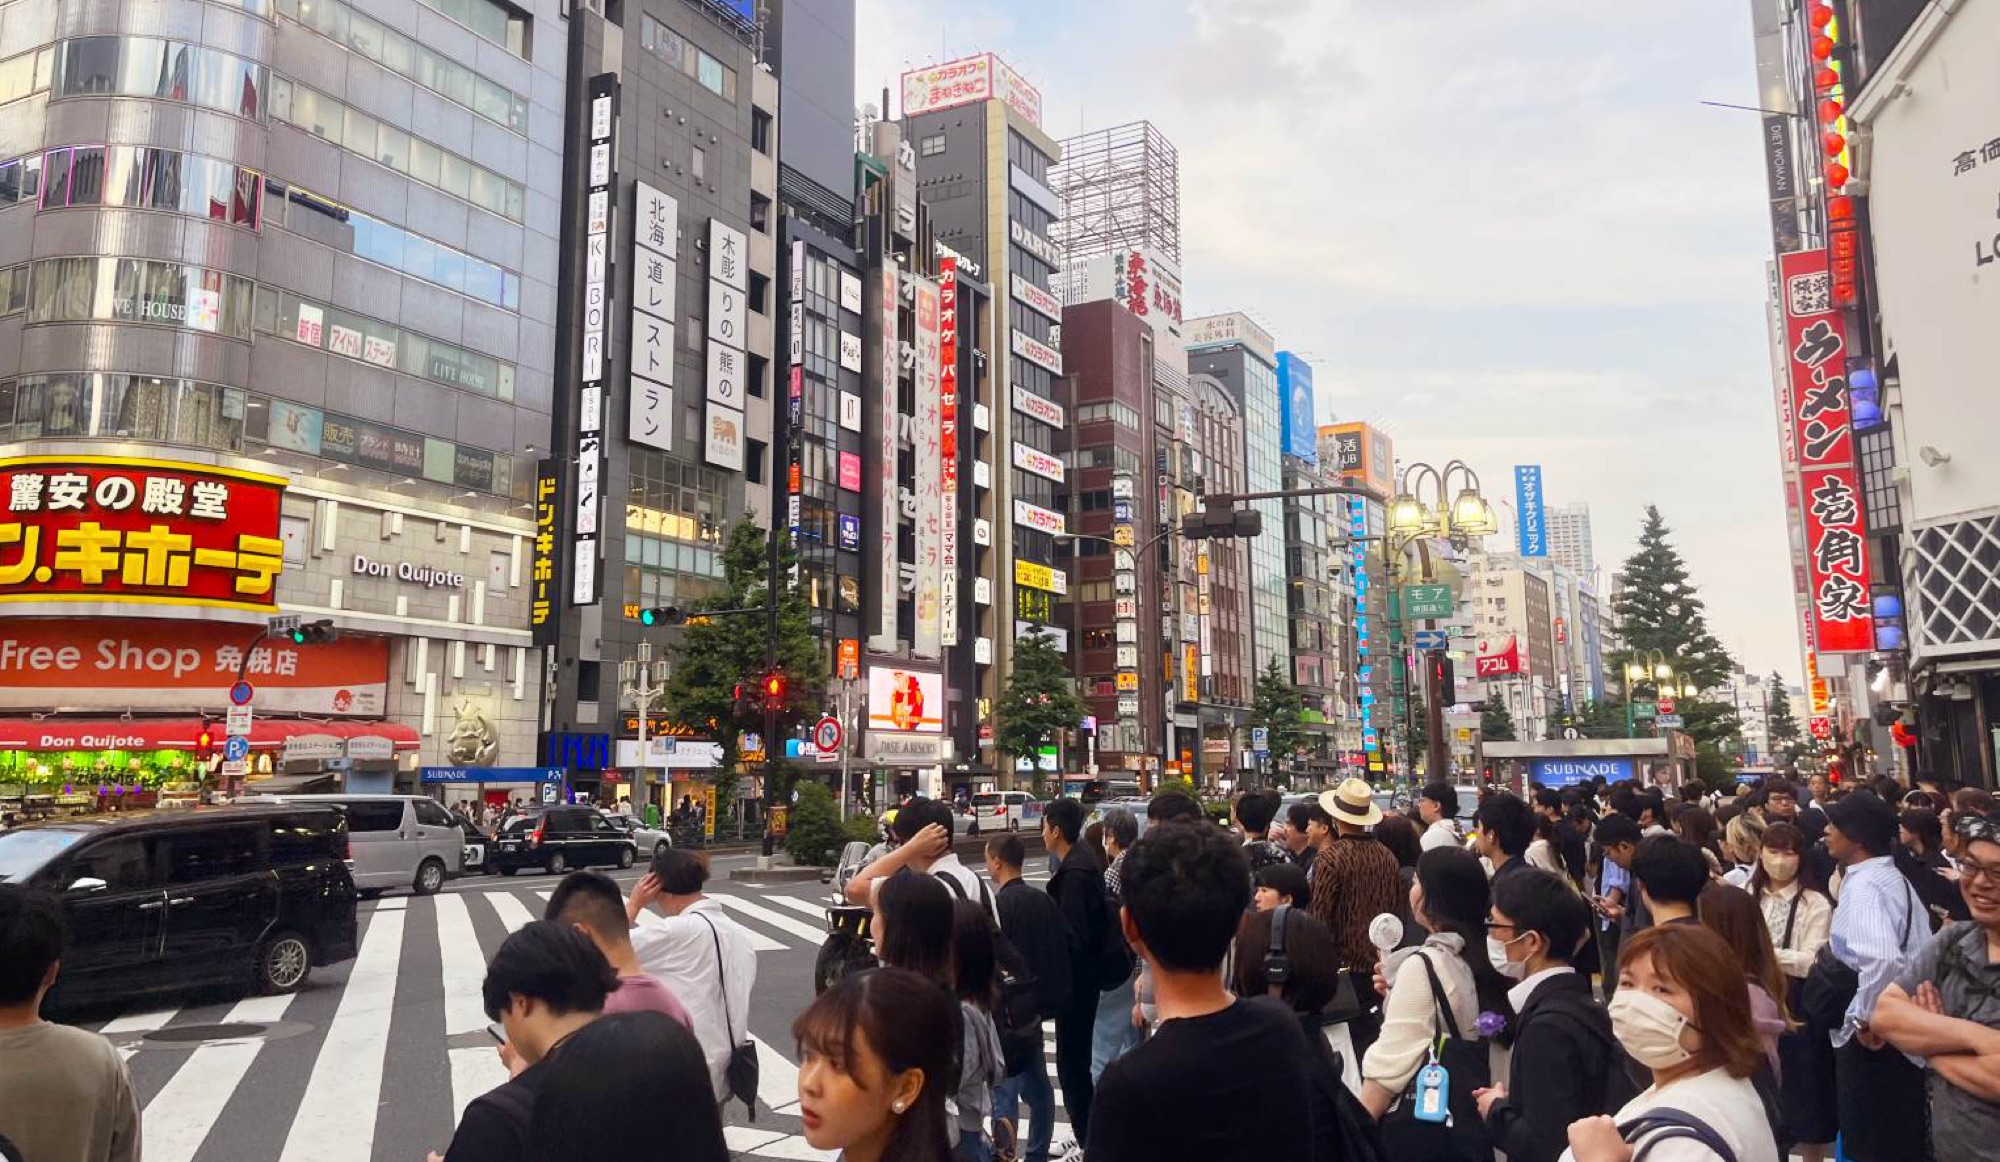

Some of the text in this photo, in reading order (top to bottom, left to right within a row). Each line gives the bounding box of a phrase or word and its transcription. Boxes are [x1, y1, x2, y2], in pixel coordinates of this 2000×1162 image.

[936, 64, 977, 80] カラオケ
[929, 78, 985, 105] まねきねこ
[1771, 126, 1786, 191] DIET WOMAN
[1012, 220, 1059, 263] DARTS
[140, 301, 186, 320] HOUSE
[644, 197, 666, 436] 北海道レストラン
[718, 233, 736, 398] 木彫りの熊の
[299, 318, 394, 364] 新宿 アイドル ステージ
[1796, 322, 1846, 460] ラーメン
[323, 422, 354, 446] 販売
[359, 434, 390, 450] ブランド
[1032, 455, 1056, 474] カラオケ
[9, 472, 228, 519] 驚安の殿堂
[1032, 511, 1057, 529] カラオケ
[1523, 482, 1539, 554] オザキクリニック
[1813, 476, 1872, 621] 壱角家
[353, 555, 464, 588] Don Quijote
[944, 572, 954, 629] パーティー
[1411, 588, 1444, 600] モア
[0, 639, 298, 678] Free Shop 免税店
[1480, 657, 1509, 672] アコム
[40, 735, 145, 750] Don Quijote
[229, 741, 240, 757] P
[427, 770, 467, 779] SUBNADE
[1544, 763, 1619, 775] SUBNADE
